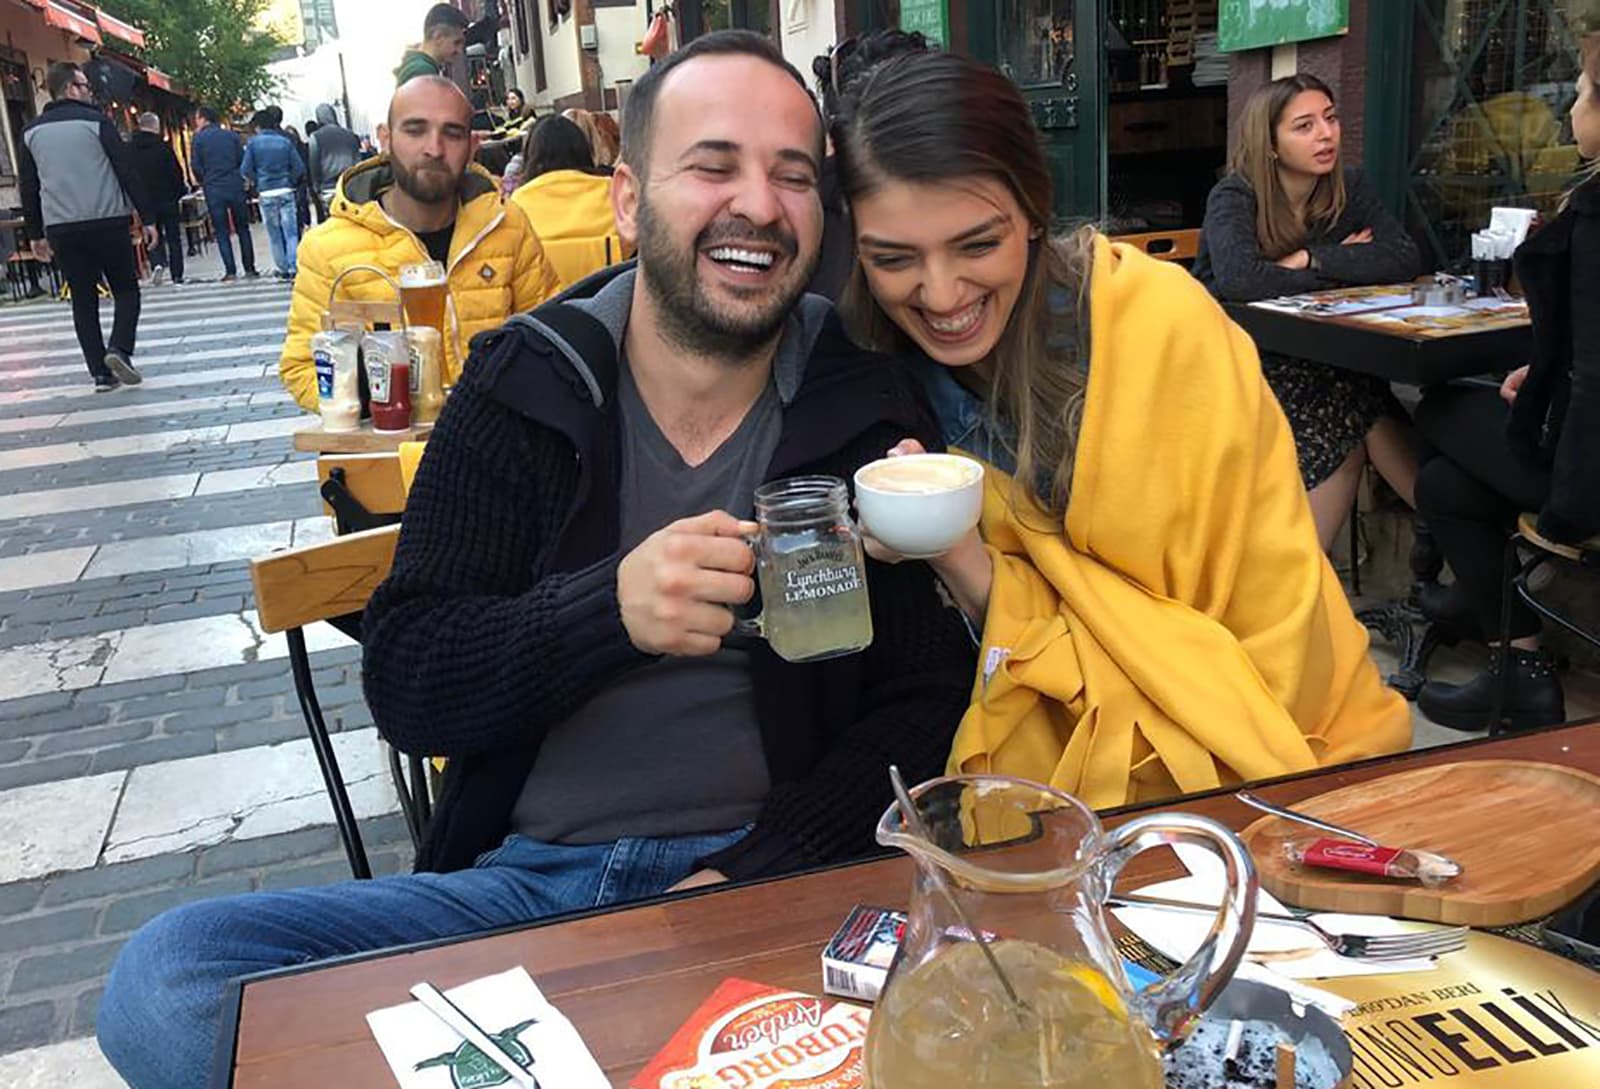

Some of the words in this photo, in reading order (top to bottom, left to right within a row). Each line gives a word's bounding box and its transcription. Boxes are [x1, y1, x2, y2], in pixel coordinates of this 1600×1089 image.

[785, 578, 862, 602] LEMONADE
[787, 565, 858, 593] Lynchburg
[723, 1000, 822, 1050] Amber
[715, 1010, 868, 1089] TUBORG
